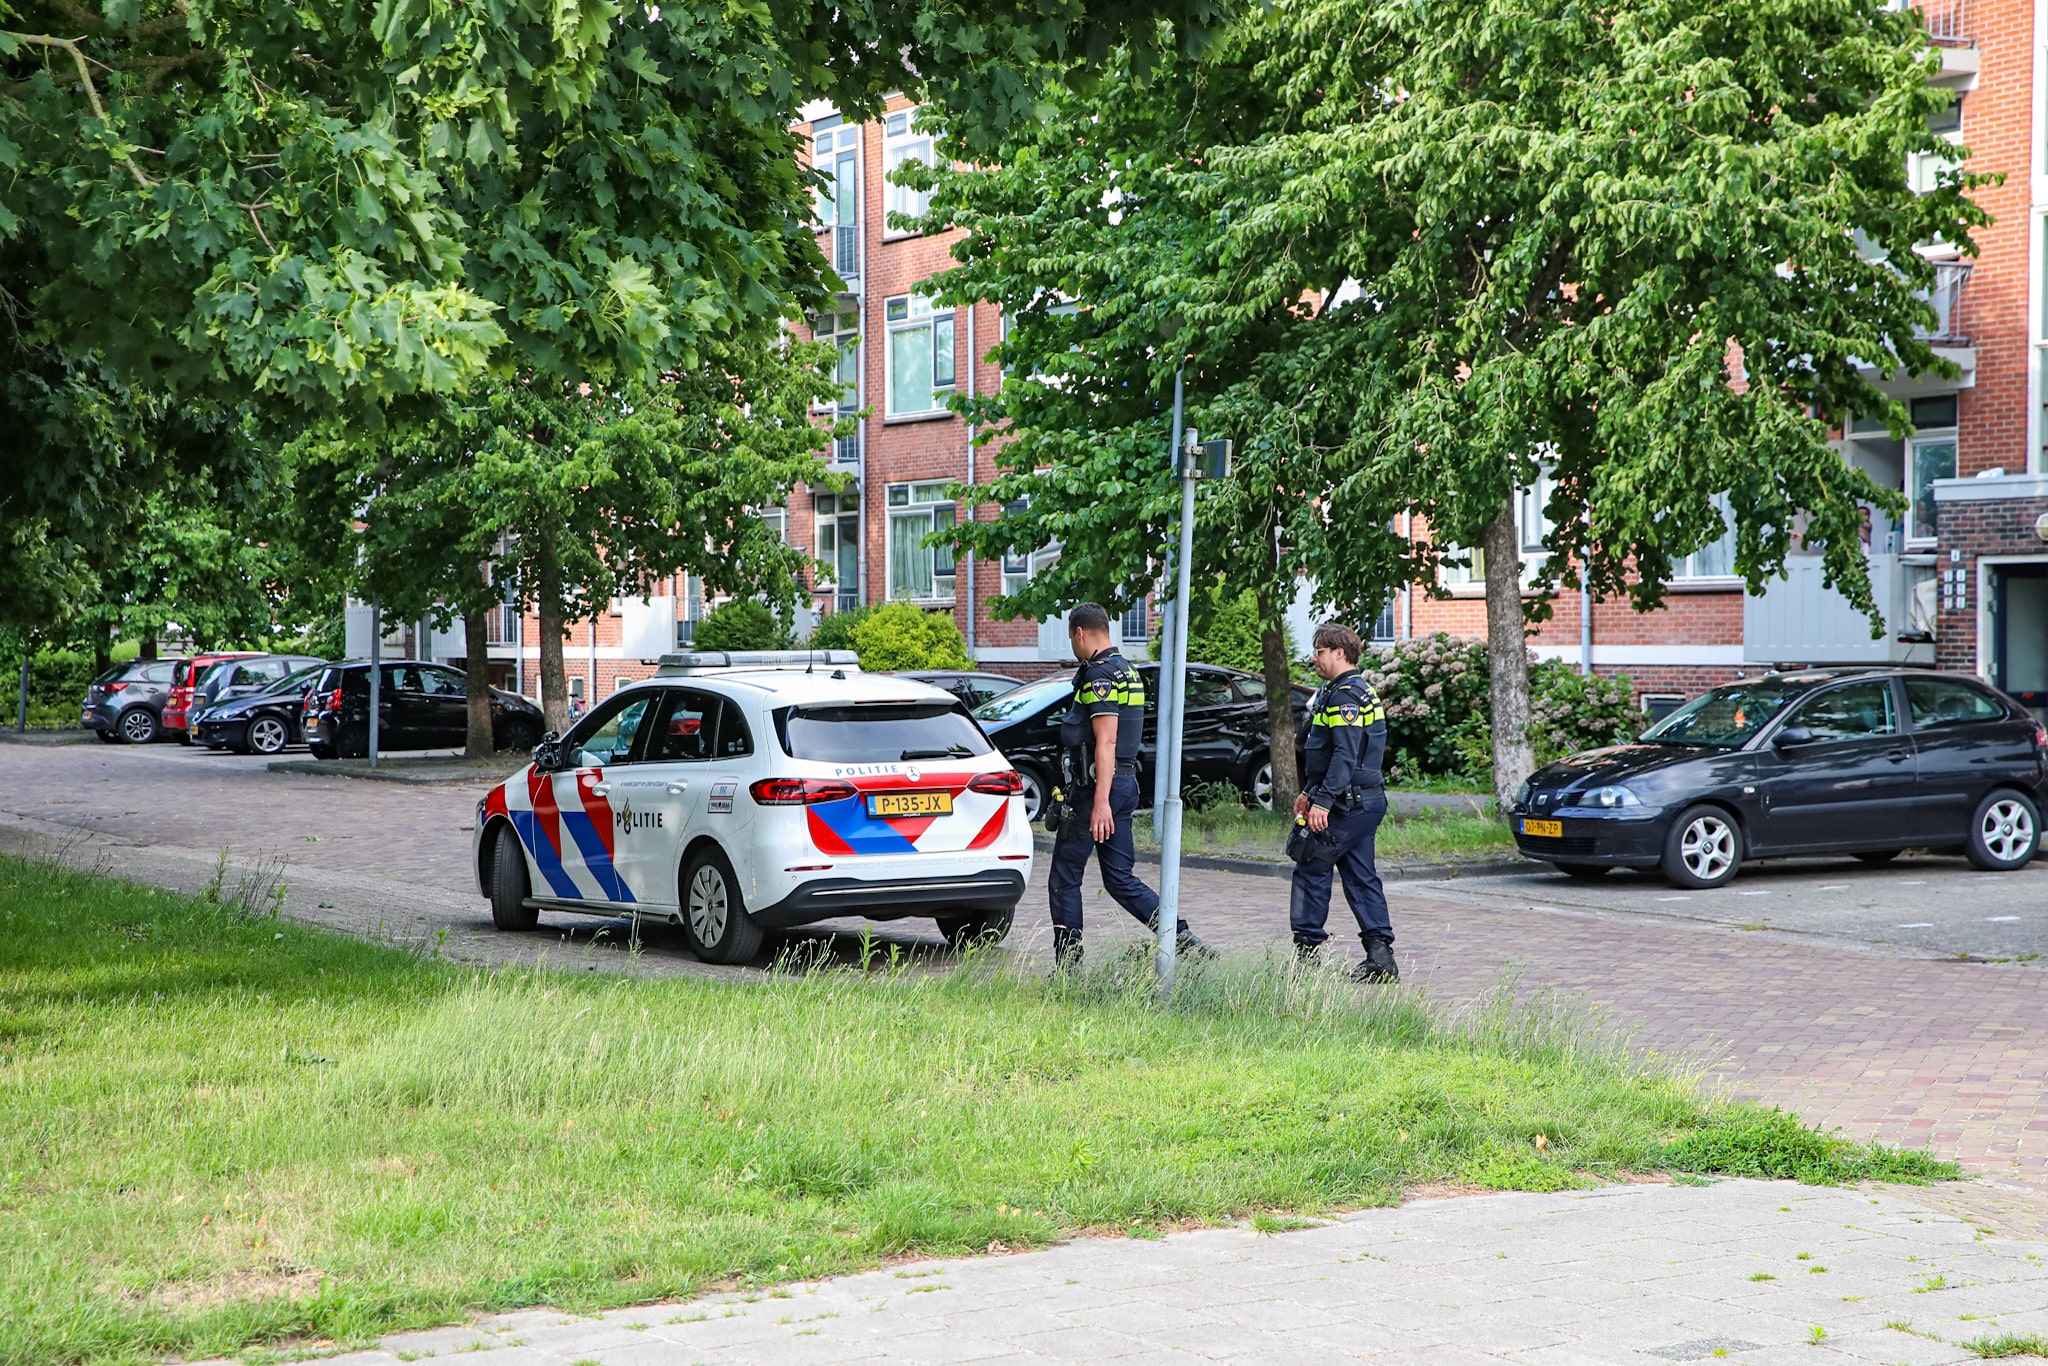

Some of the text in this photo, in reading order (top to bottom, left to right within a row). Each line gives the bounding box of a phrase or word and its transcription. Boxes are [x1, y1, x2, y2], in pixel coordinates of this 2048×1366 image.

[835, 765, 899, 776] POLITIE
[882, 796, 942, 812] P-135-JX
[616, 812, 663, 834] POLITIE
